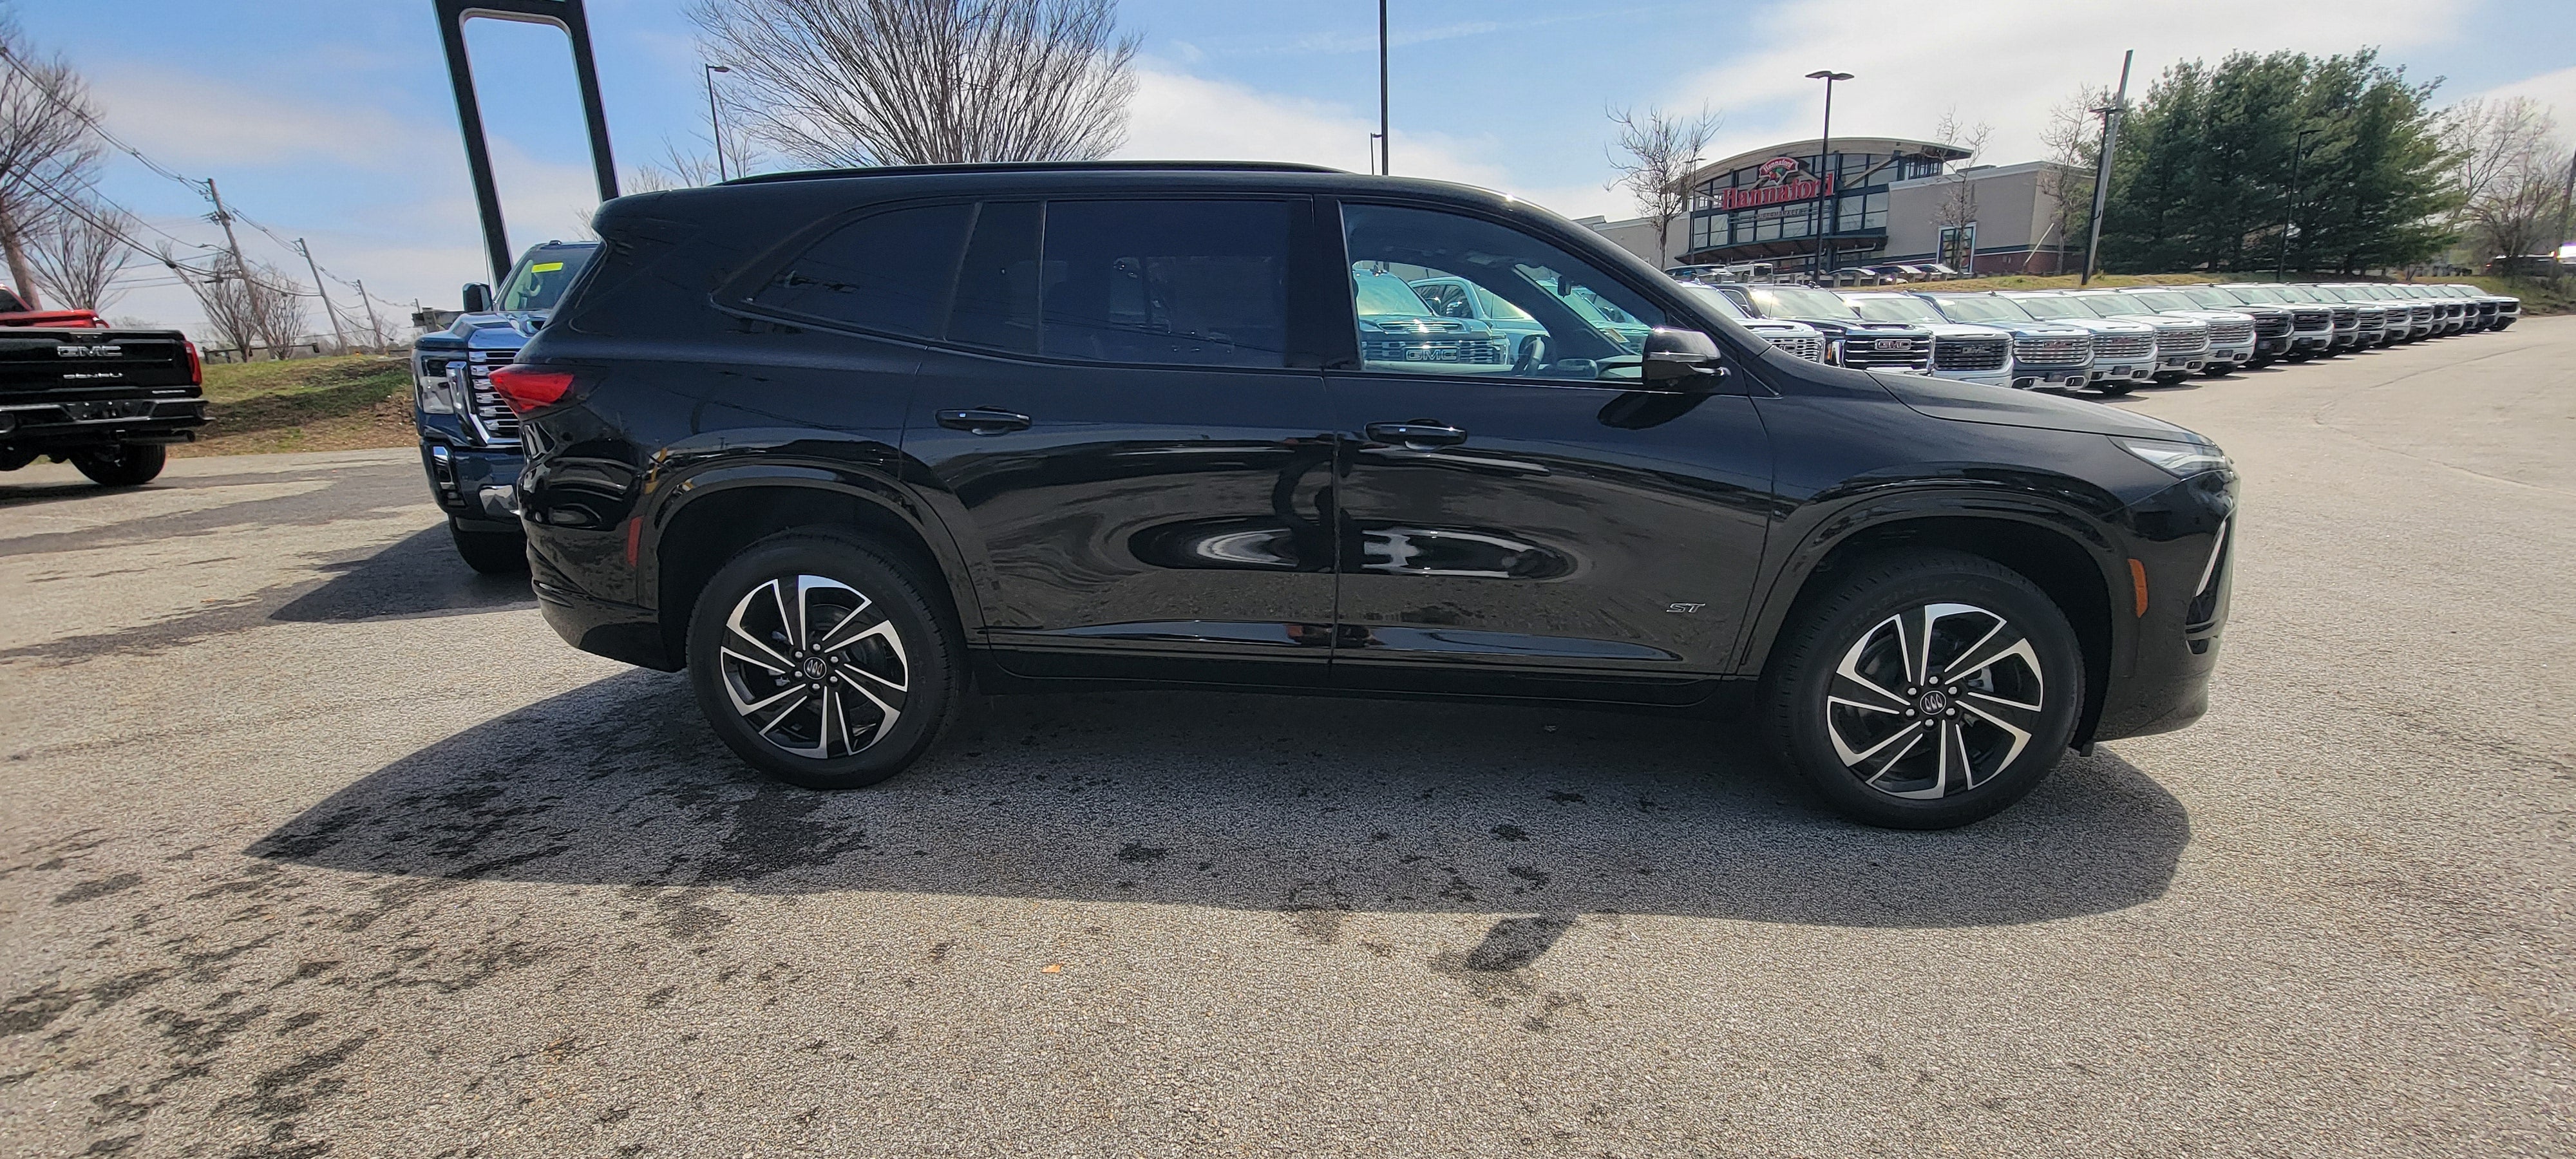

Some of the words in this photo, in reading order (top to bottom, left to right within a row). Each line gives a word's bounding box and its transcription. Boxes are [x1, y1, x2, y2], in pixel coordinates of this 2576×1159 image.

[1763, 159, 1794, 173] Hannaford
[1722, 173, 1834, 210] Hannaford
[57, 346, 123, 357] GMC
[1406, 350, 1457, 361] GMC
[1666, 603, 1706, 613] ST
